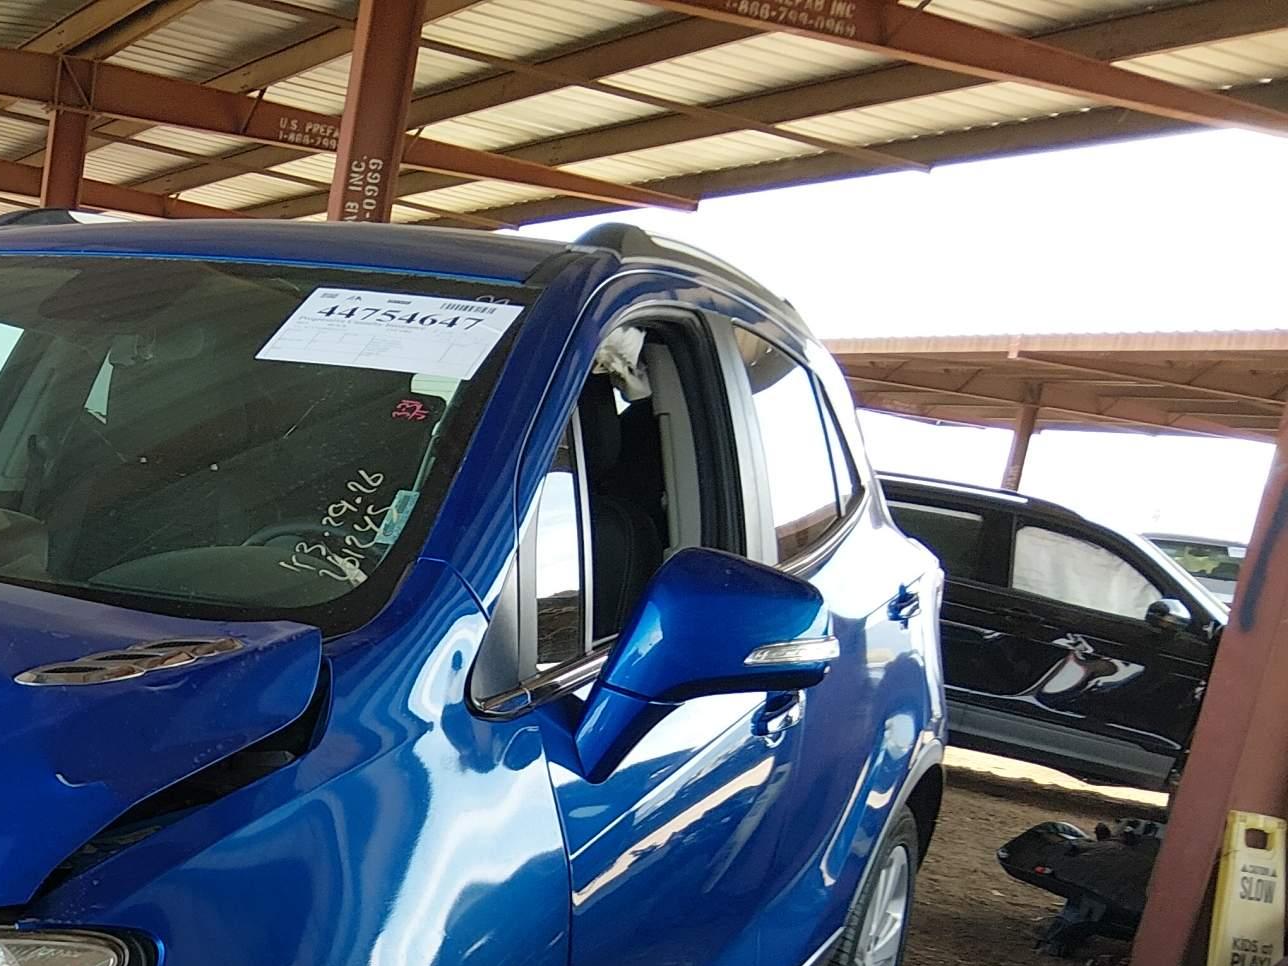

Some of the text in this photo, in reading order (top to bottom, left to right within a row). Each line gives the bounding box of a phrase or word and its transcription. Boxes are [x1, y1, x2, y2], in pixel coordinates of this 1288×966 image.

[348, 155, 367, 191] INC.
[317, 304, 484, 330] 44754647
[1240, 876, 1276, 904] SLOW
